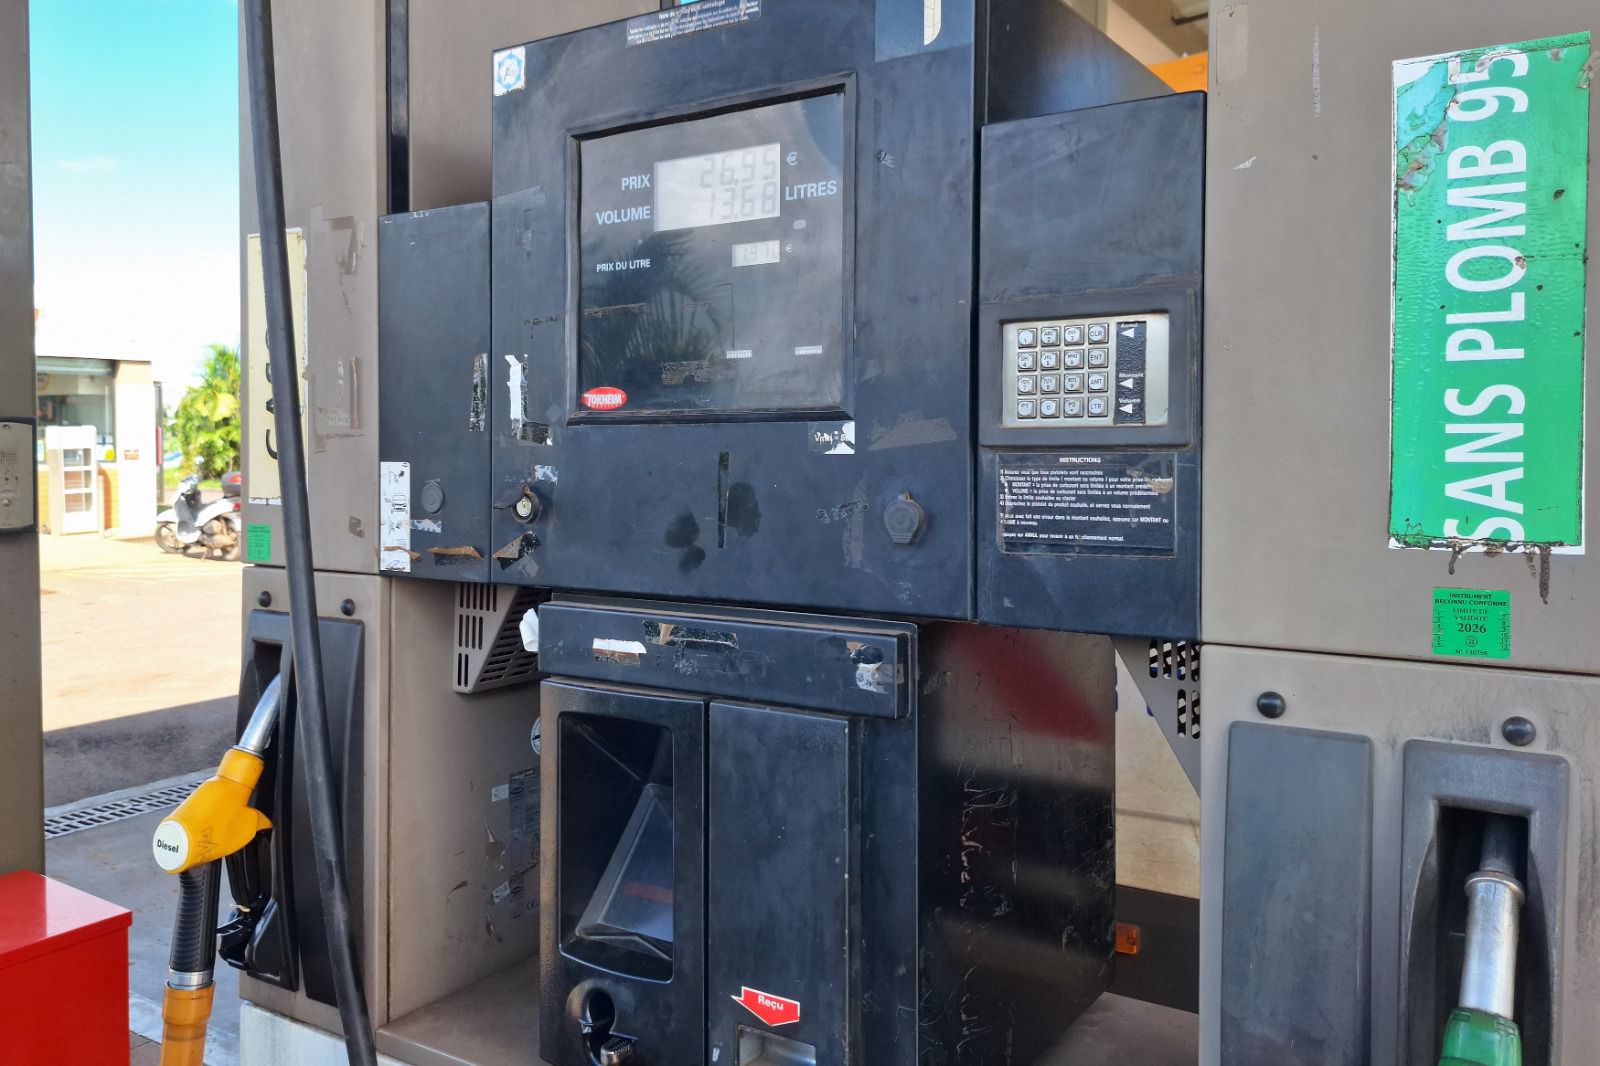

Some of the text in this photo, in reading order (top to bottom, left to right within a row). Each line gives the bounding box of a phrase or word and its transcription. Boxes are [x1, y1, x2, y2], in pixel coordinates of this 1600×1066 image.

[621, 174, 650, 192] PRIX
[786, 151, 799, 166] €
[596, 206, 651, 225] VOLUME
[785, 180, 837, 201] LITRES
[596, 263, 614, 273] PRIX
[615, 261, 627, 271] DU
[629, 259, 651, 270] LITRE
[1444, 49, 1529, 542] SANS PLOMB 95
[584, 394, 623, 407] TOKHEIM
[1457, 622, 1487, 634] 2026
[157, 839, 179, 853] Diesel
[757, 995, 784, 1011] Reçu
